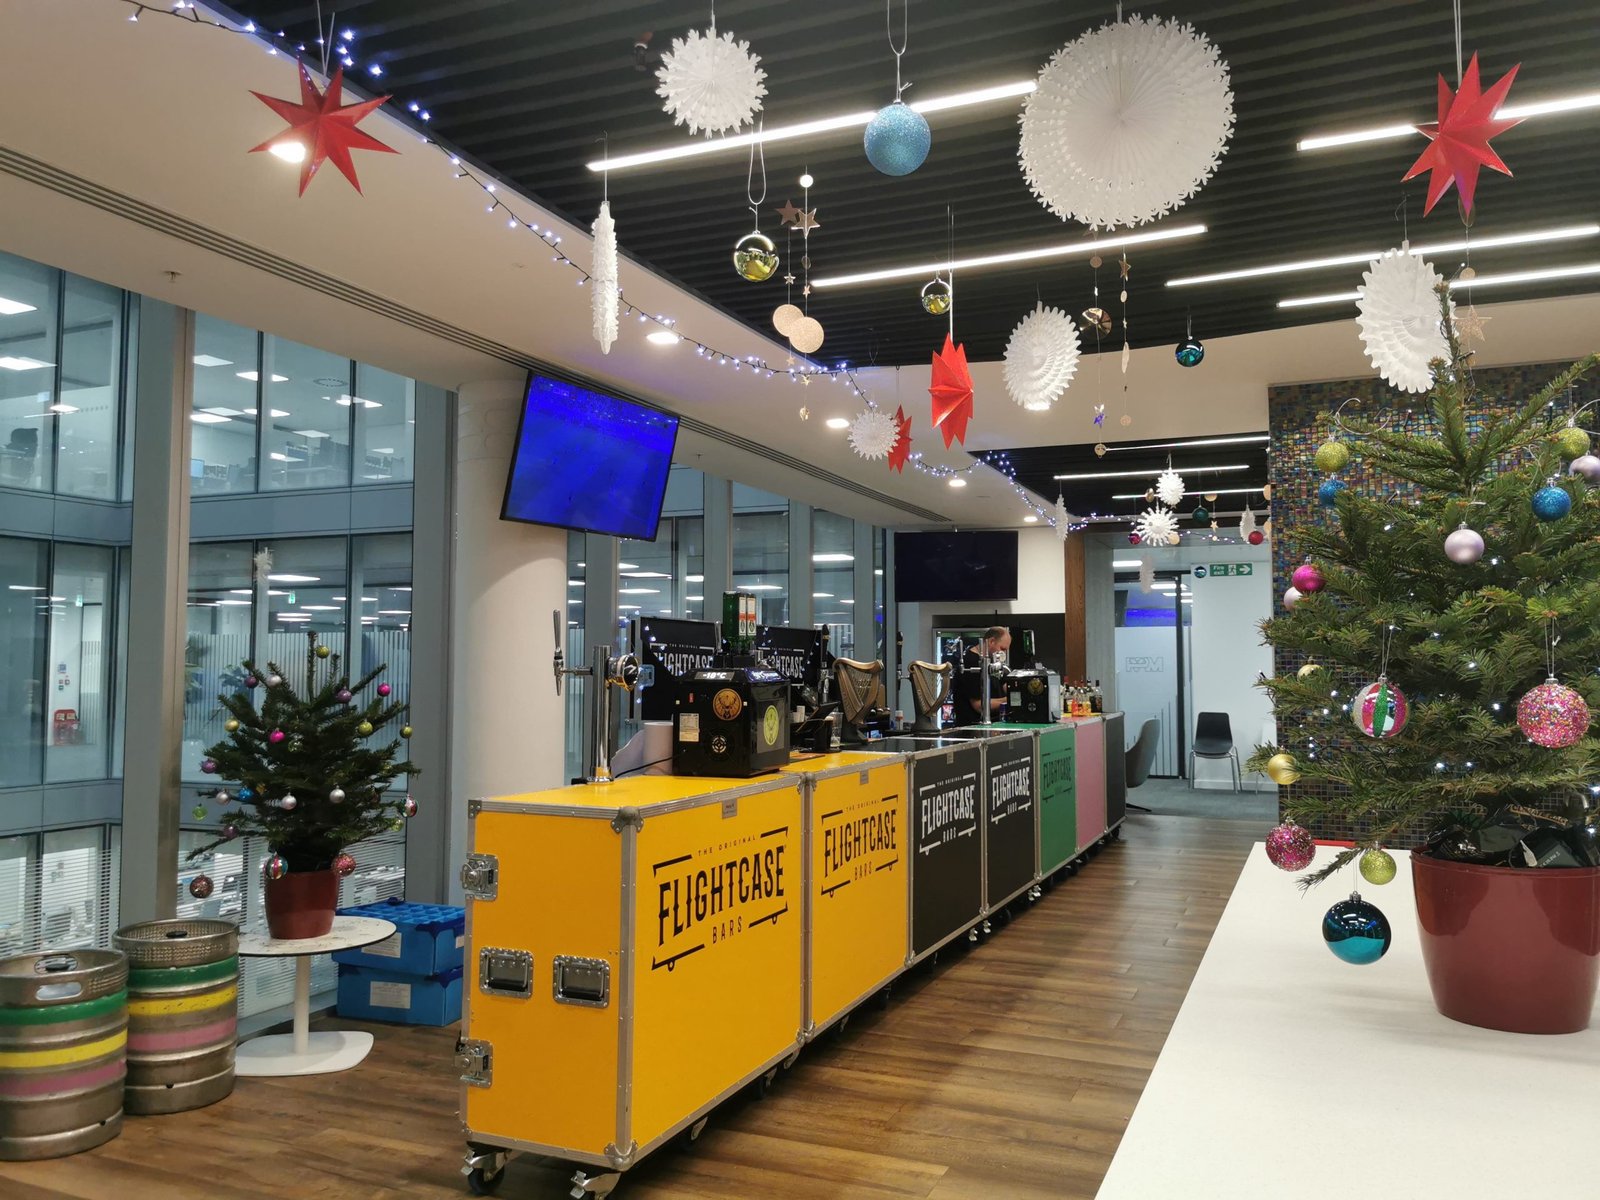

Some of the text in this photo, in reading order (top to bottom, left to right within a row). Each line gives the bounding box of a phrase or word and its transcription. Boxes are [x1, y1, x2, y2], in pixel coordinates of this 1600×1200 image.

[921, 784, 975, 840] FLIGHTCASE
[991, 766, 1030, 811] FLIGHTCASE
[698, 834, 756, 857] THE ORIGINAL
[824, 809, 897, 878] FLIGHTCASE
[658, 845, 785, 947] FLIGHTCASE
[712, 915, 743, 945] BARS
